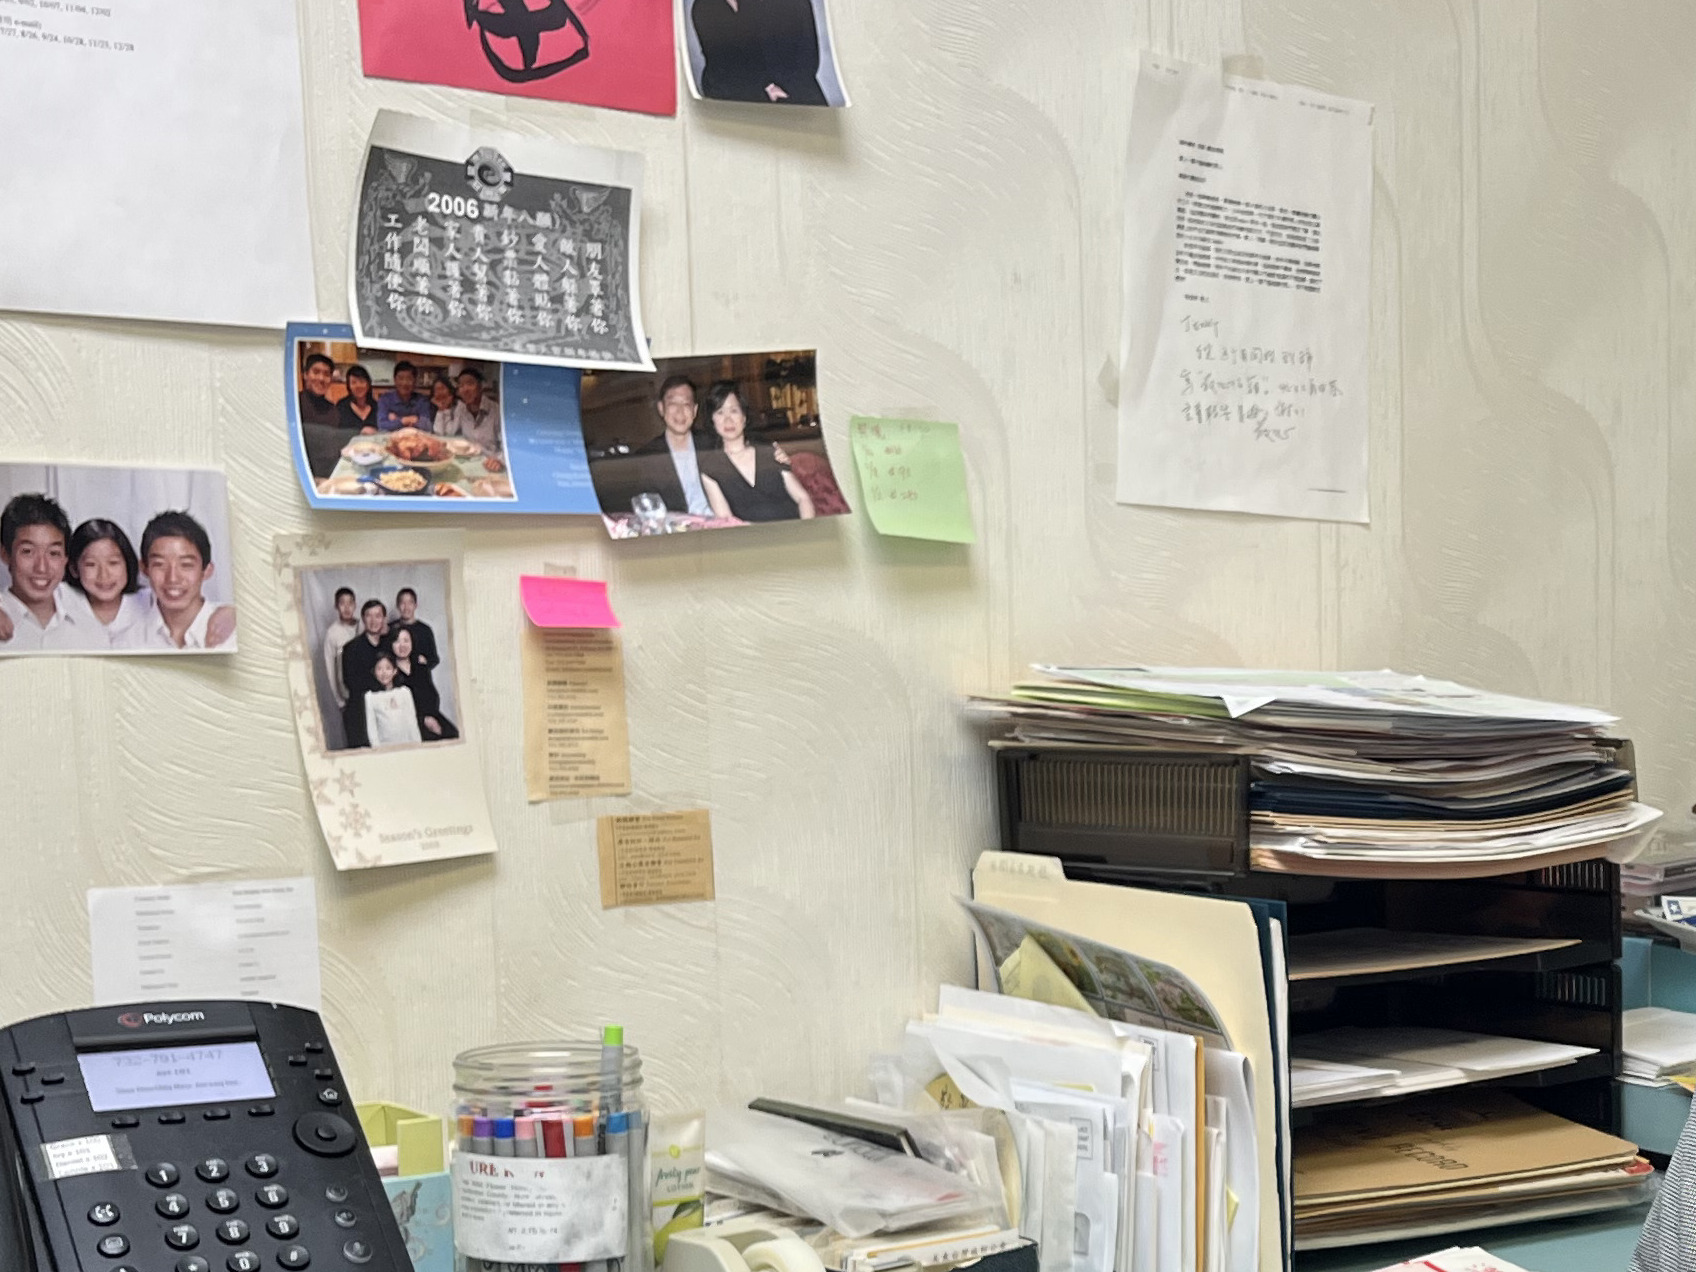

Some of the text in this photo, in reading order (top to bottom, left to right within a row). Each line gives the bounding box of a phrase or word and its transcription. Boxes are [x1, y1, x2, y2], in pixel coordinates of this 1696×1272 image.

[427, 192, 479, 218] 2006
[424, 824, 474, 838] Greetings
[144, 1011, 205, 1025] Polycom
